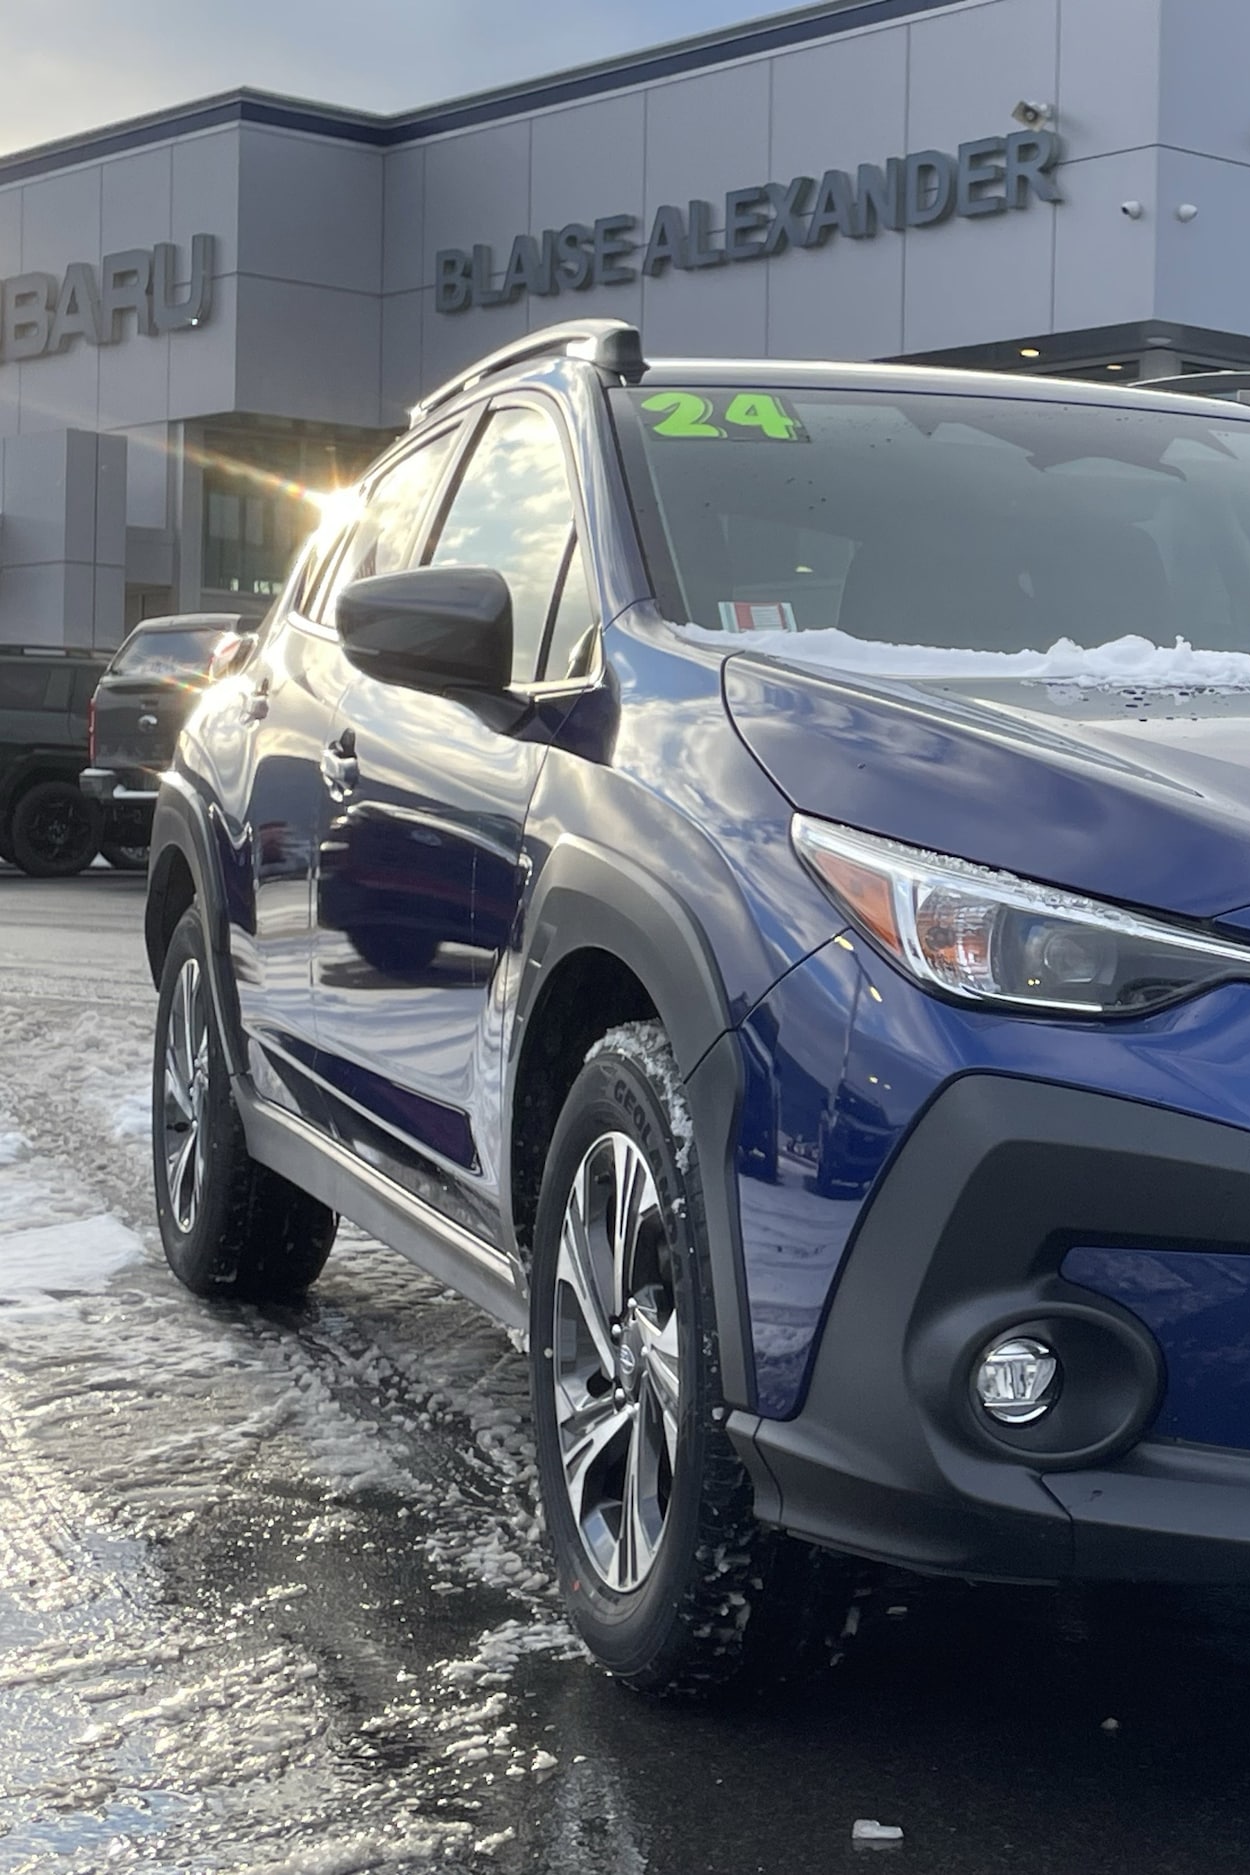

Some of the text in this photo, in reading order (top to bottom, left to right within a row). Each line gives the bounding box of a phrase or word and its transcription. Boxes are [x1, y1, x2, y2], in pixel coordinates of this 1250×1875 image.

[435, 130, 1065, 313] BLAISE ALEXANDER
[0, 232, 215, 366] BARU
[641, 391, 802, 441] 24
